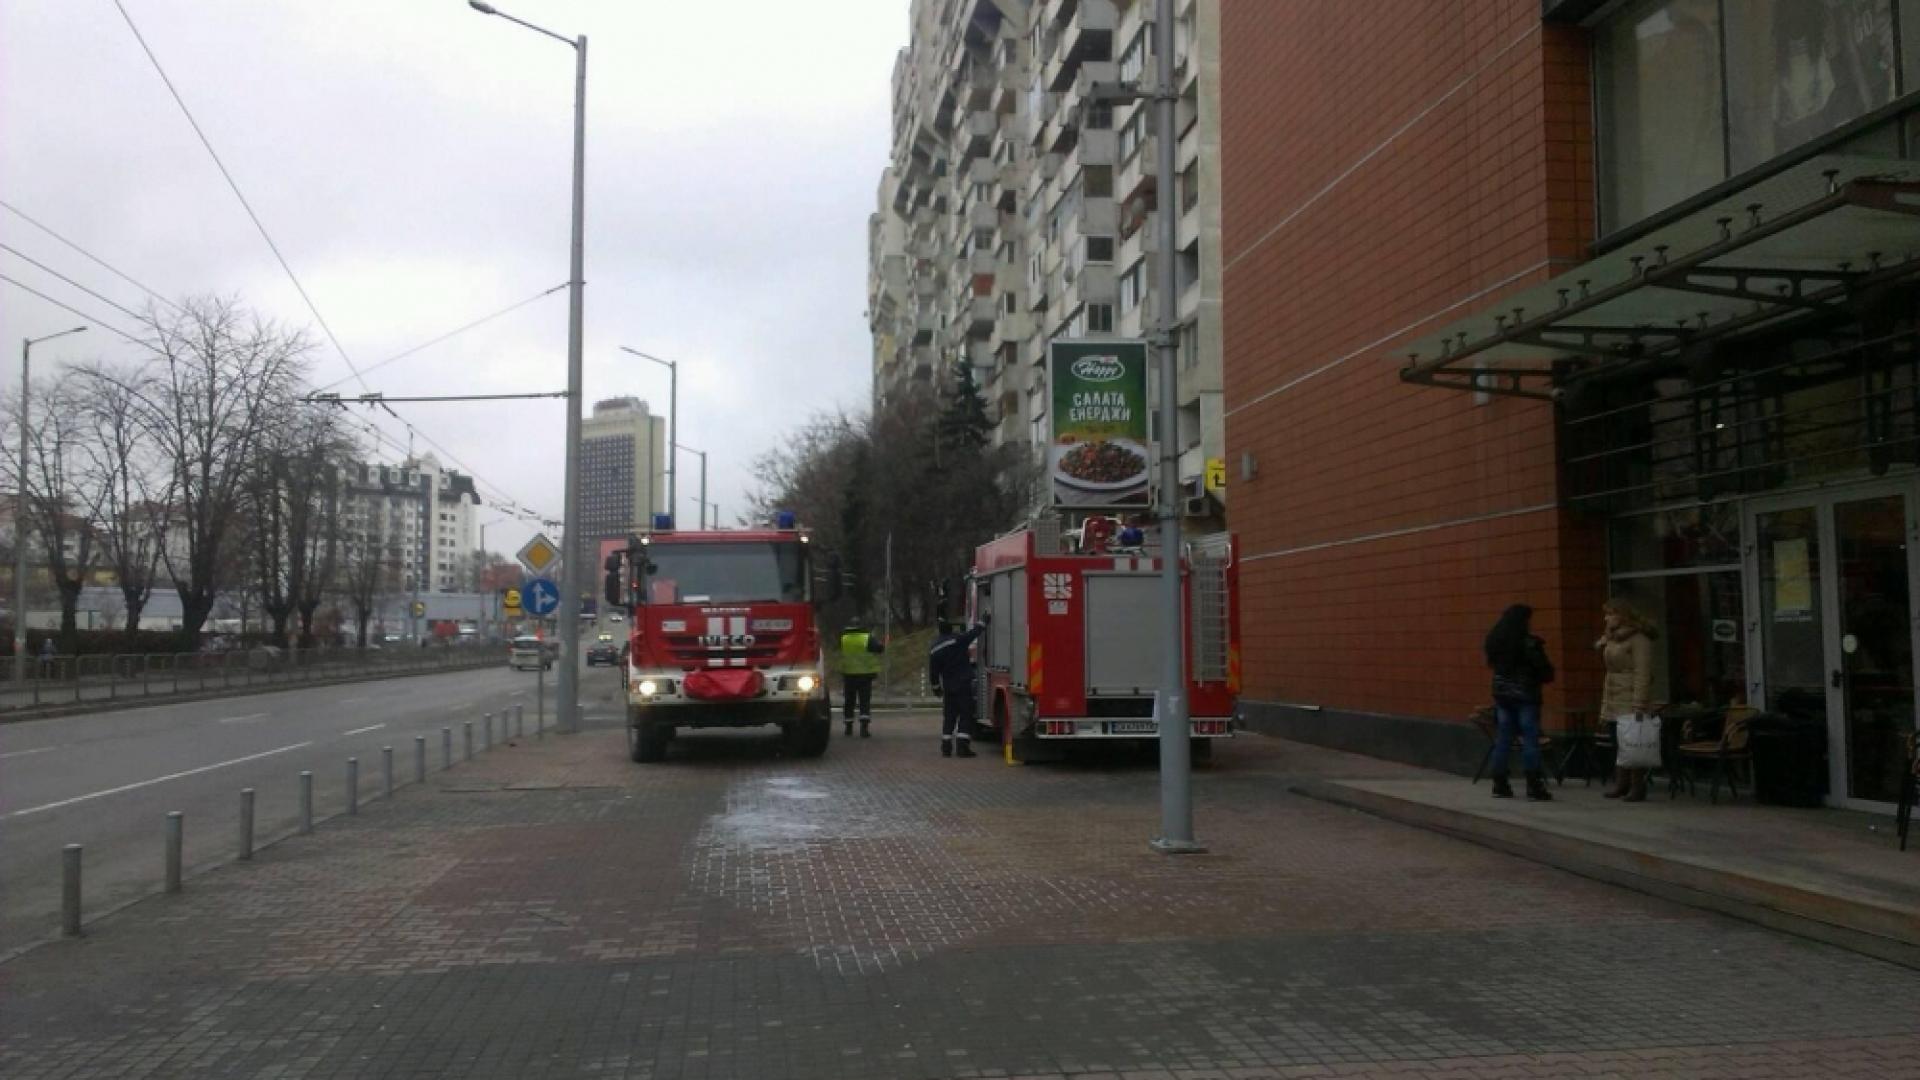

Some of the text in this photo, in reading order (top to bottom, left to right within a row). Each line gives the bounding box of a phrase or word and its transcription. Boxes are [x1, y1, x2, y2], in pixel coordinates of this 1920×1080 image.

[1072, 392, 1125, 407] САЛАТА
[1070, 406, 1131, 421] ЕНЕРДЖИ
[698, 634, 755, 647] IVECO
